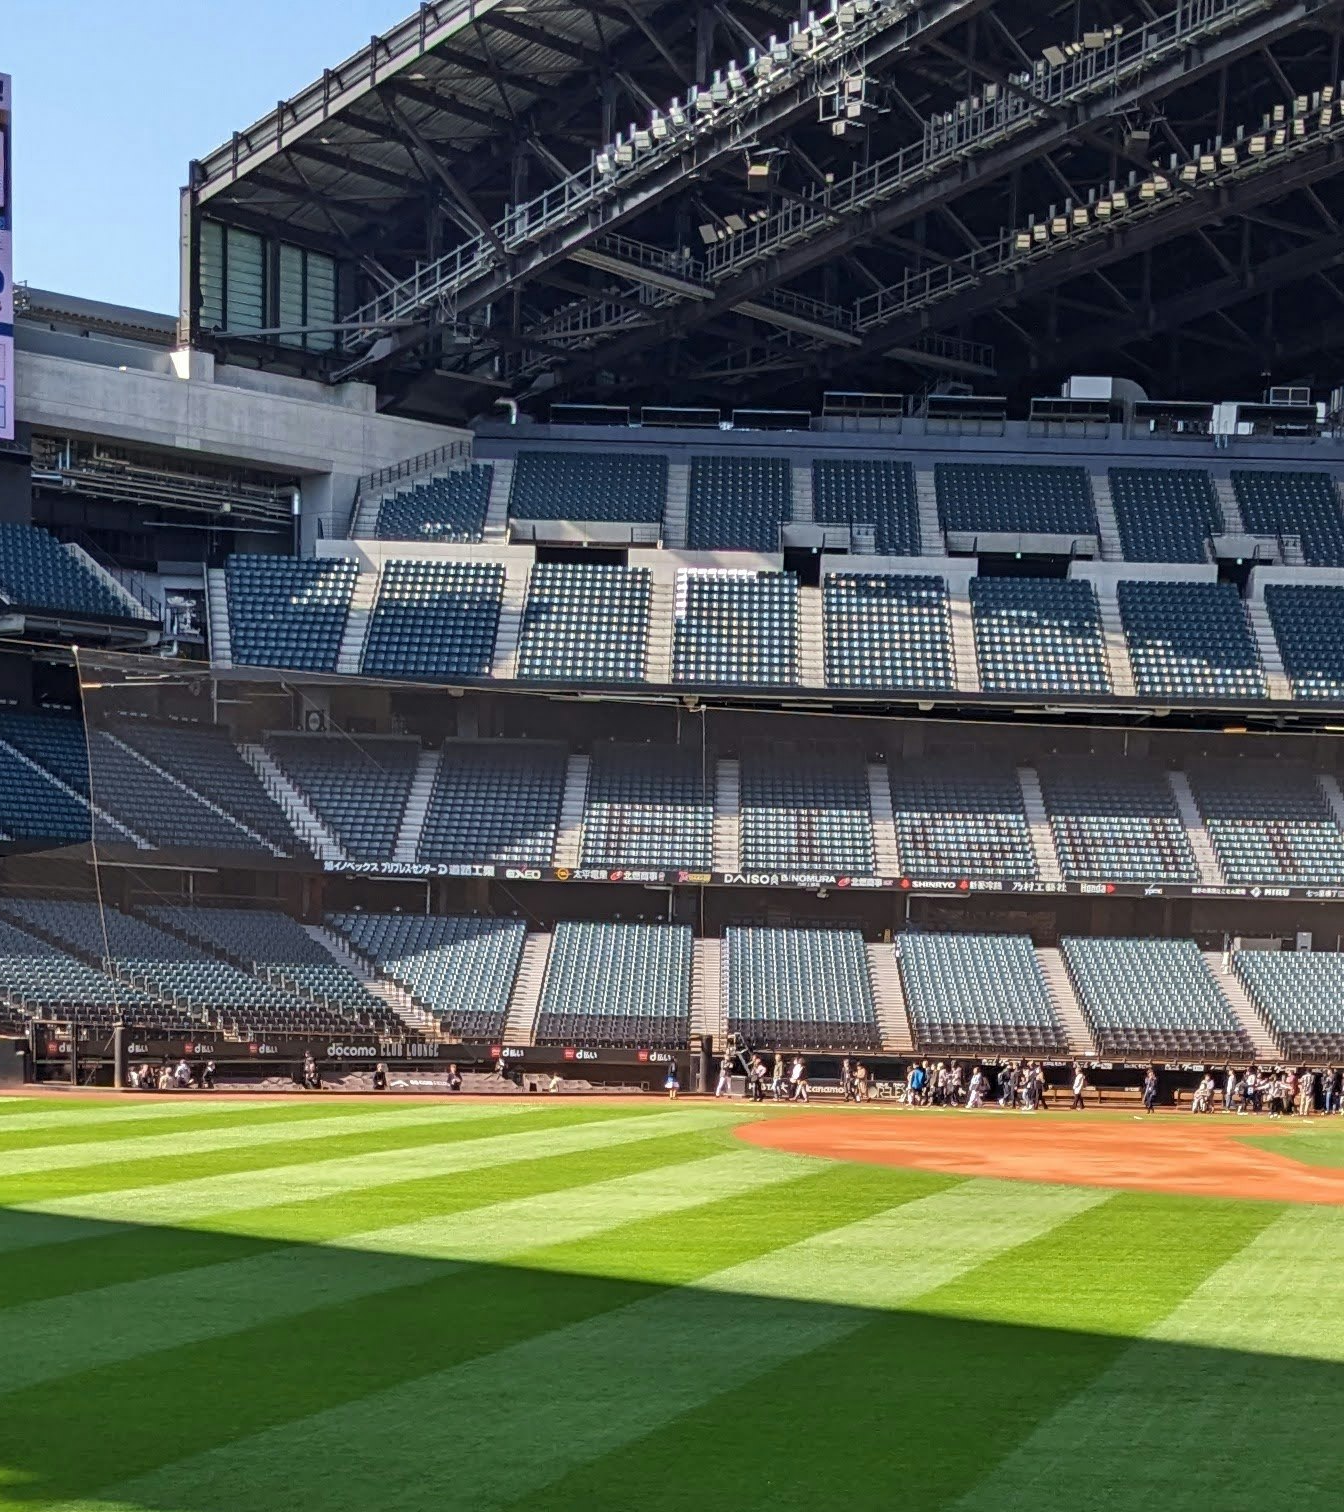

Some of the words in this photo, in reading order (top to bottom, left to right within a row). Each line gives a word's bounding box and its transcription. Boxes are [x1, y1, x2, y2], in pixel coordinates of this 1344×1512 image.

[724, 874, 770, 885] DAISO
[791, 874, 836, 884] NOMURA
[911, 881, 956, 889] SHINRYO
[327, 1043, 377, 1057] docomo
[380, 1043, 403, 1057] CLUB
[407, 1043, 439, 1057] LOUNGE
